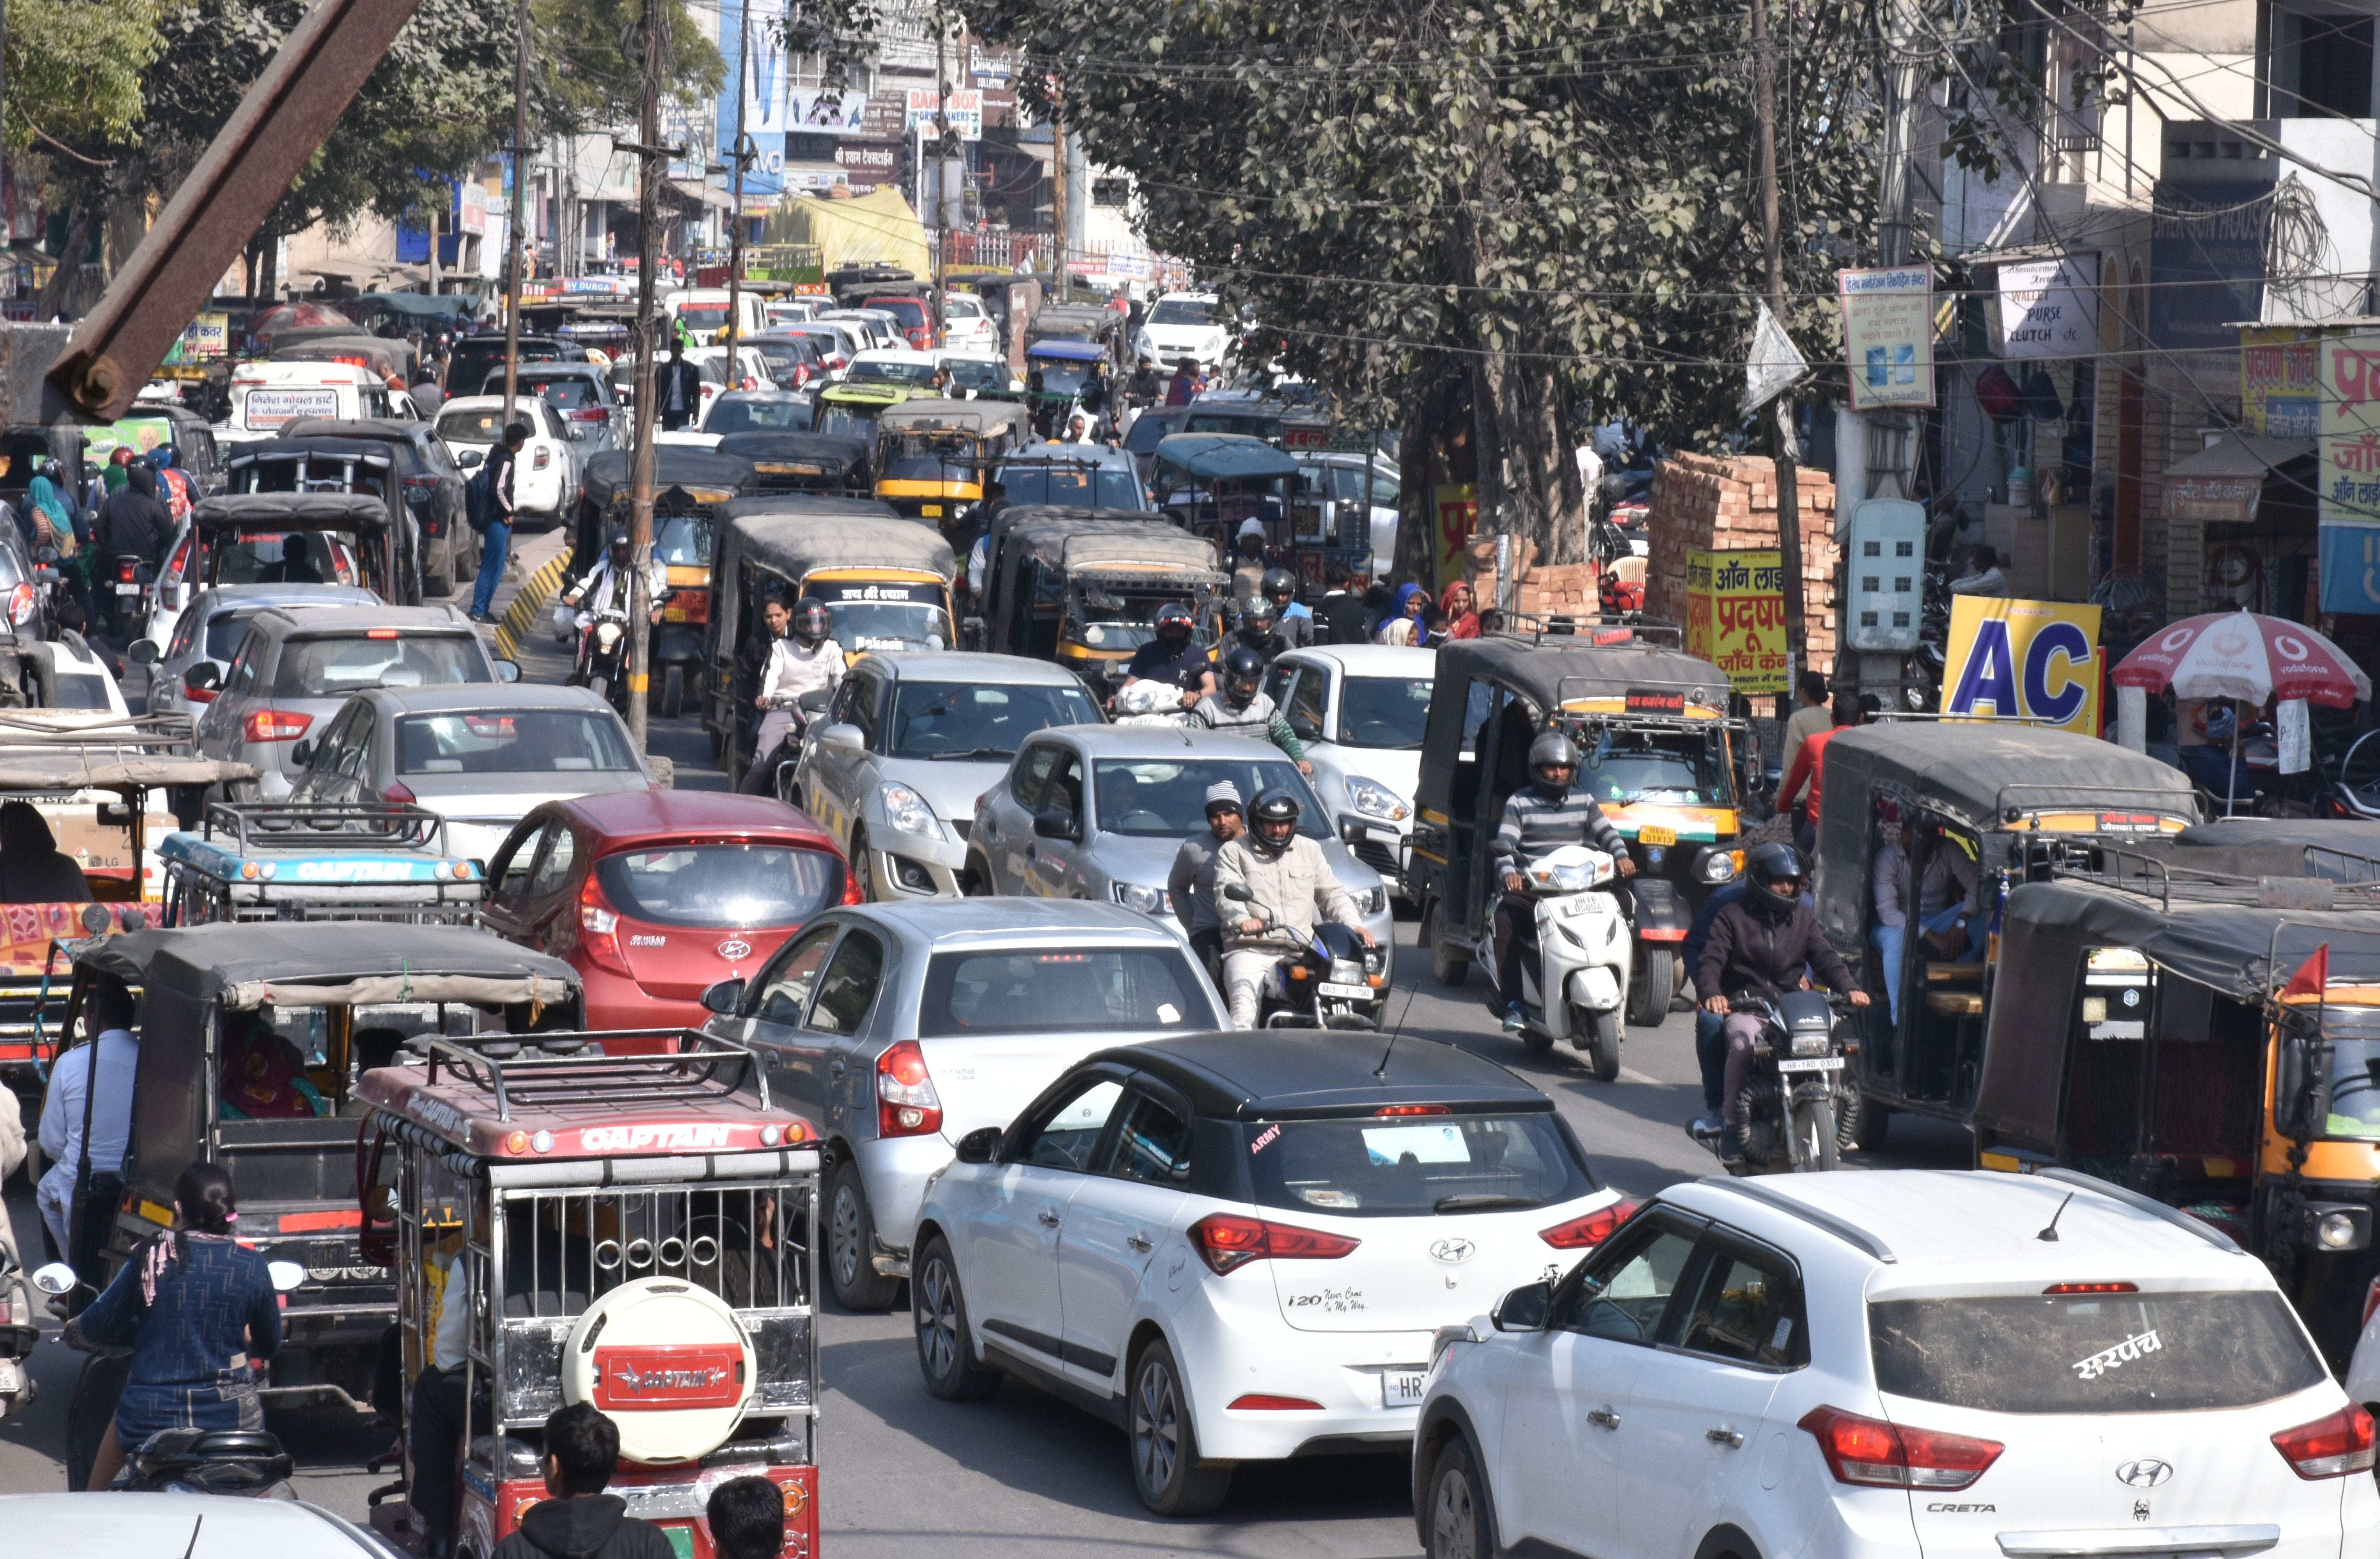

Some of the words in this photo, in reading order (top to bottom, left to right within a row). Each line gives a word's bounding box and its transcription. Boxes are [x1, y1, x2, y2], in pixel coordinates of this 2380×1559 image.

[977, 78, 1004, 90] COLLECTION
[911, 92, 947, 109] BAN
[951, 92, 977, 109] BOX
[835, 147, 844, 164] श्री
[845, 151, 861, 165] श्याम
[2012, 290, 2048, 302] WALLET
[2027, 306, 2061, 323] PURSE
[2010, 328, 2051, 341] CLUTCH
[2332, 475, 2355, 501] ऑन
[1715, 560, 1749, 591] ऑन
[841, 589, 862, 600] जय
[864, 586, 878, 600] श्री
[1717, 648, 1754, 671] जाँच
[2138, 653, 2174, 665] vodafone
[2196, 659, 2253, 671] vodafone
[1948, 617, 2092, 726] AC
[2280, 663, 2328, 674] vodafone
[1761, 673, 1771, 682] में
[105, 857, 119, 867] LG
[298, 862, 413, 880] CAPTAIN
[581, 1123, 730, 1150] CAPTAIN
[1251, 1124, 1281, 1155] ARMY
[1324, 1289, 1342, 1300] Never
[1345, 1286, 1362, 1300] Come
[1324, 1302, 1332, 1313] In
[1334, 1300, 1347, 1314] My
[2072, 1329, 2162, 1379] सरपंच
[642, 1370, 707, 1388] CAPTAIN
[1400, 1377, 1423, 1398] HR
[1926, 1502, 1997, 1513] CRETA
